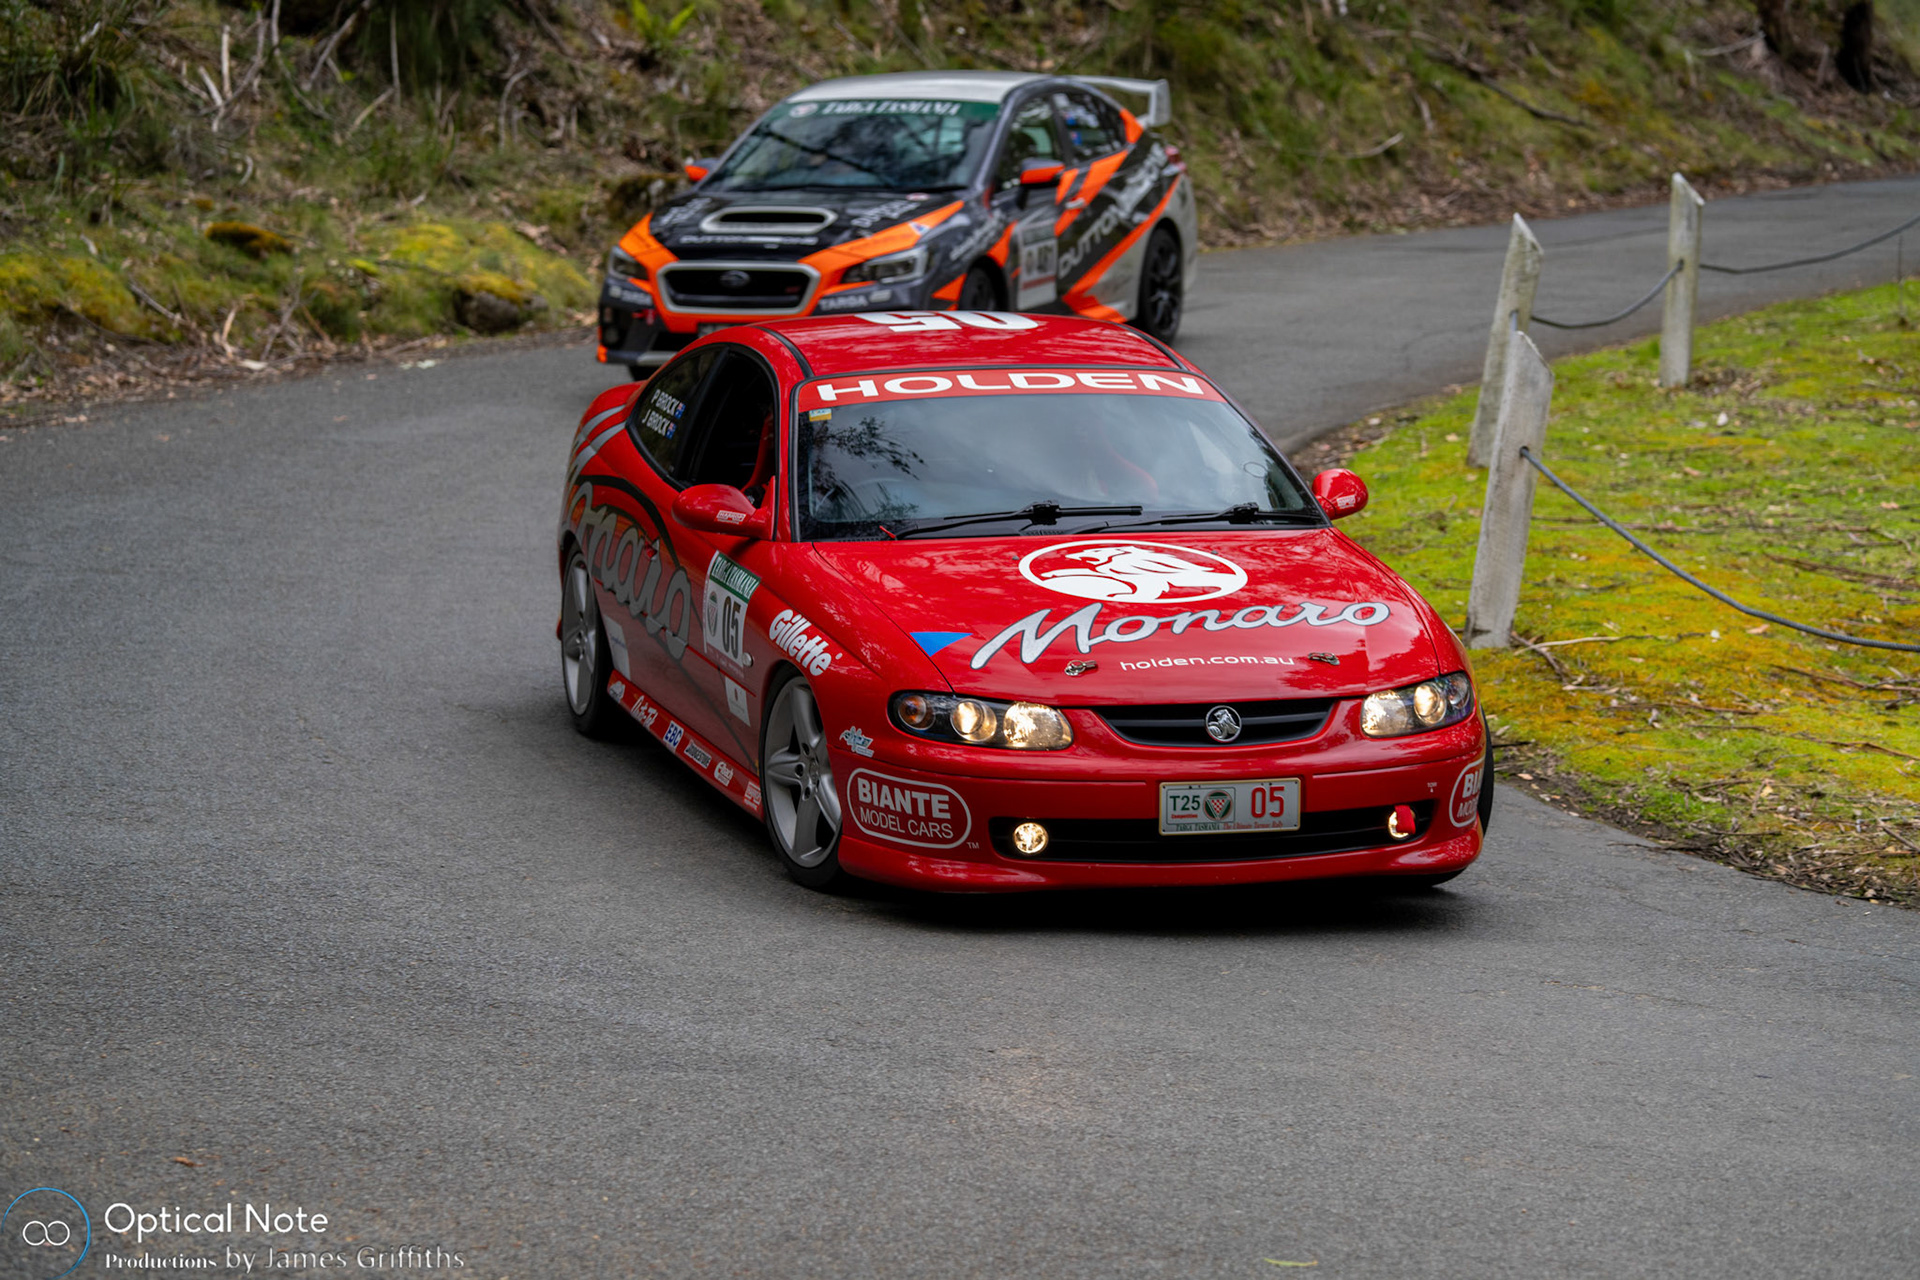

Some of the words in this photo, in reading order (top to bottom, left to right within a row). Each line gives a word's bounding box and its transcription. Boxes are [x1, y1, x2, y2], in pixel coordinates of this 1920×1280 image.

[1058, 203, 1131, 280] DUTTON
[650, 389, 661, 404] P
[817, 373, 1204, 401] HOLDEN
[641, 409, 652, 424] J
[655, 391, 680, 416] BROCK
[646, 410, 671, 437] BROCK
[722, 595, 742, 660] 05
[970, 602, 1390, 670] Monaro
[768, 609, 832, 676] Gillette
[1119, 655, 1295, 672] holden.com.au
[664, 722, 683, 748] EBC
[857, 777, 951, 819] BIANTE
[1170, 795, 1200, 811] T25
[1251, 786, 1285, 818] 05
[860, 806, 906, 834] MODEL
[907, 819, 954, 839] CARS
[967, 841, 980, 849] TM
